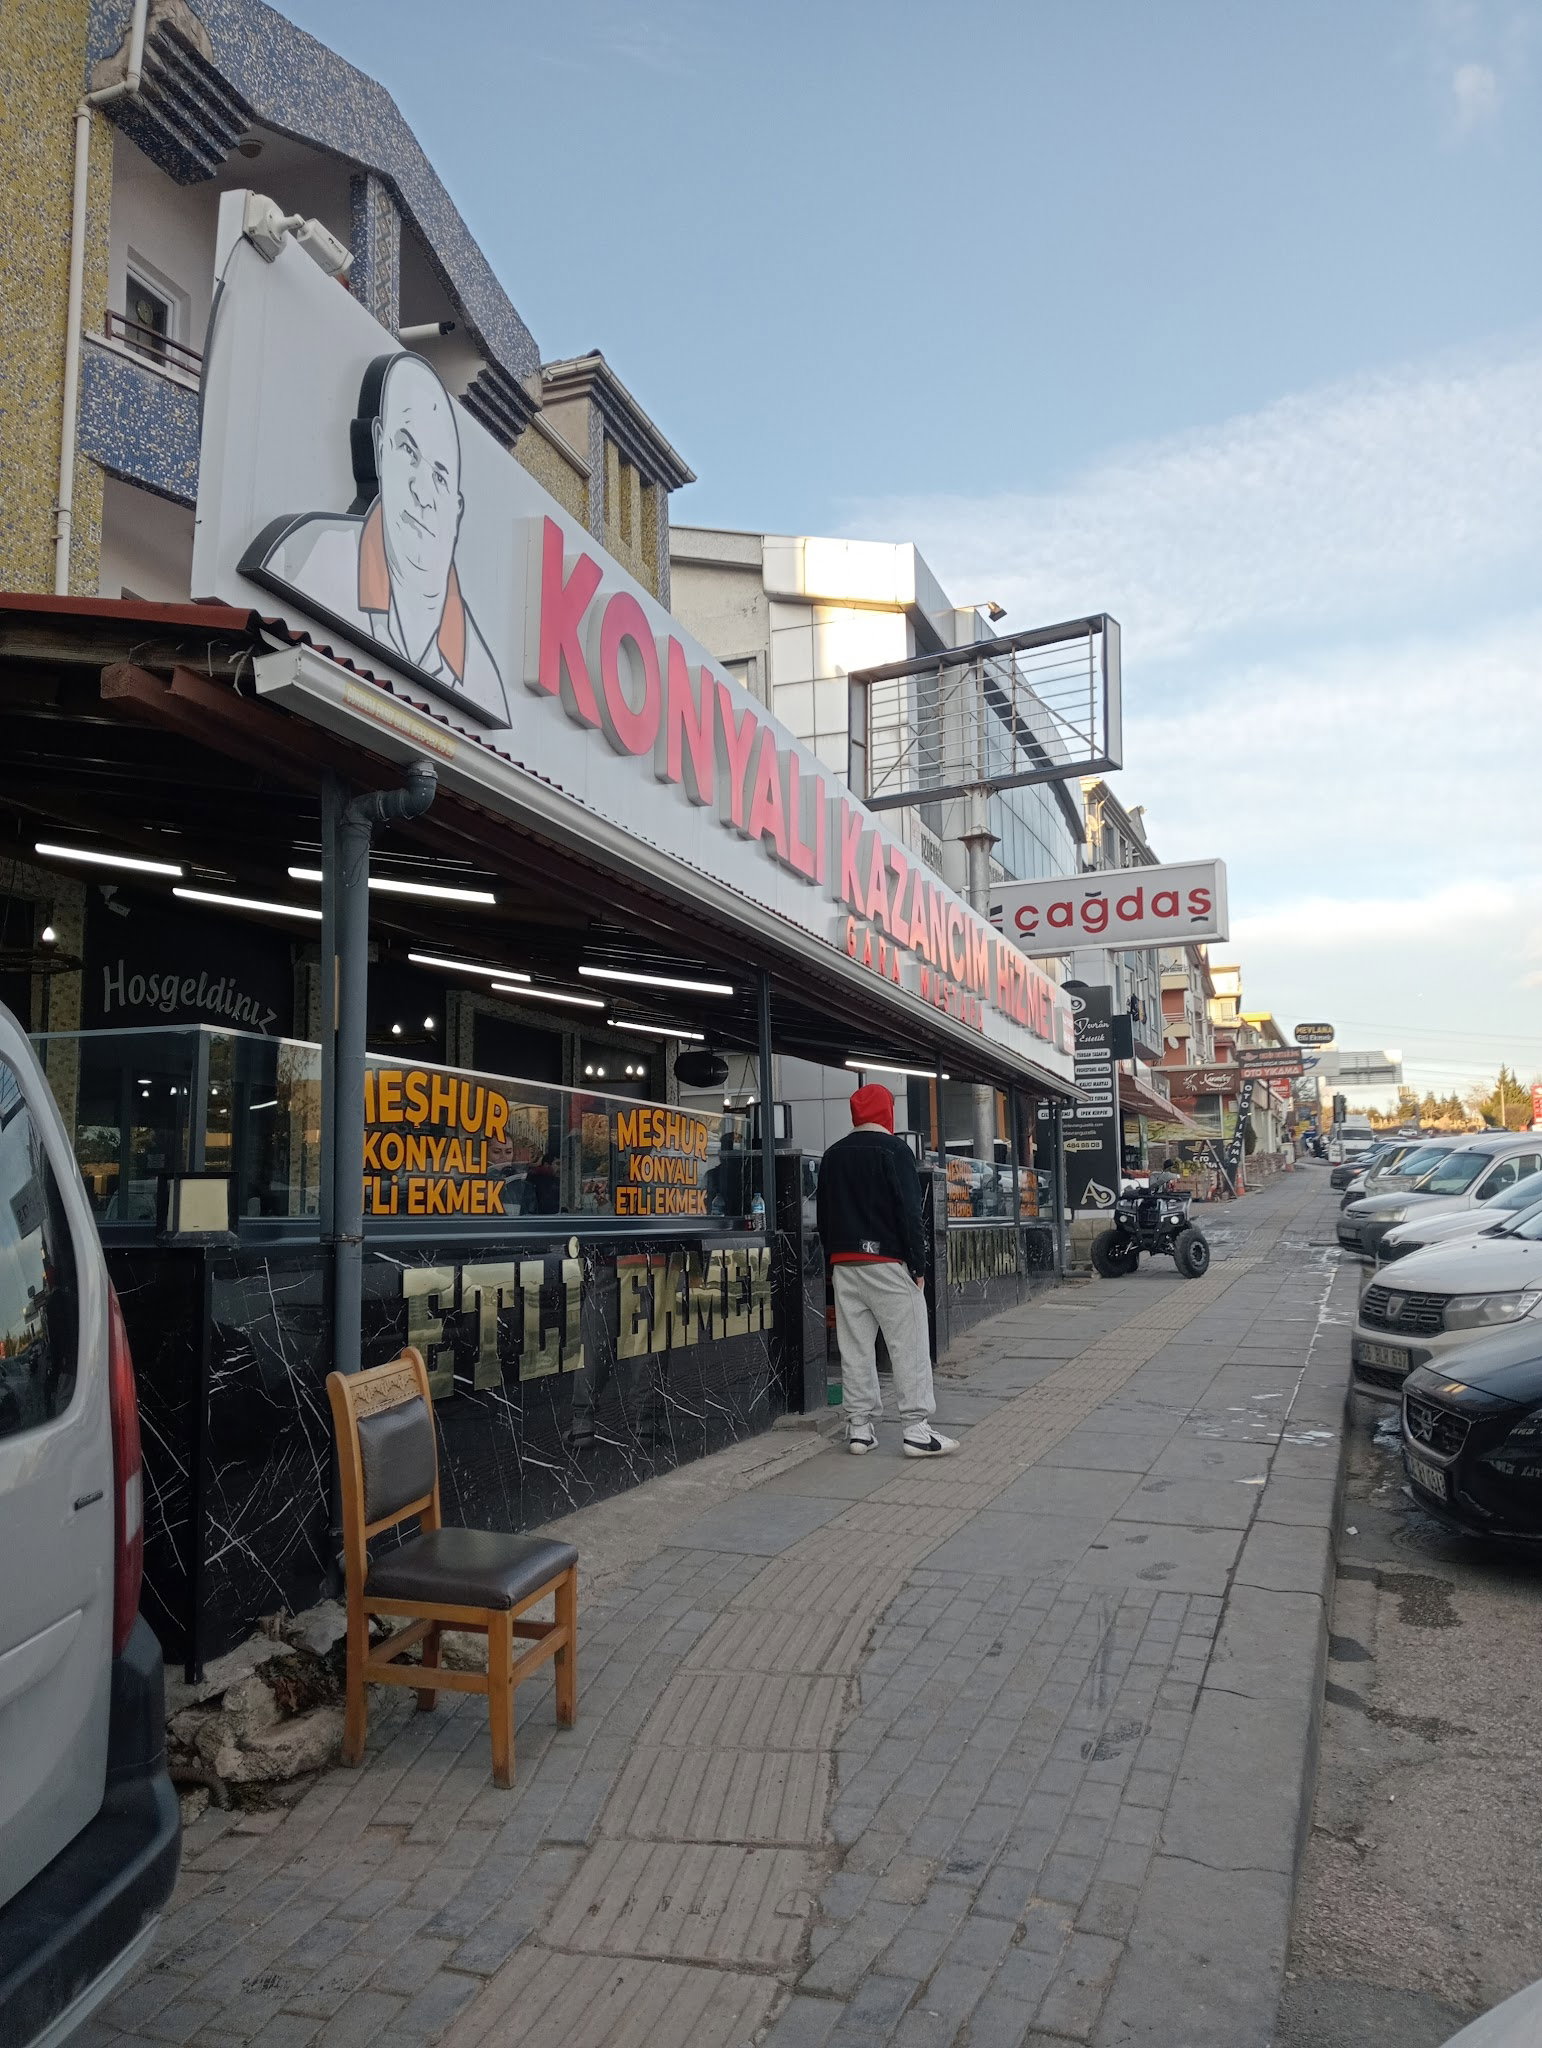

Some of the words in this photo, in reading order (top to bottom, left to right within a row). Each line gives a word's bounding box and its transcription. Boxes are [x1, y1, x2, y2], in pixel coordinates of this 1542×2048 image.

[536, 514, 826, 886] KONYALI
[840, 797, 990, 1001] KAZANCIM
[1014, 886, 1212, 940] çağdaş
[846, 915, 900, 985] GARA
[919, 964, 984, 1034] MUSTAFA
[1244, 1069, 1262, 1078] OTO
[1263, 1066, 1299, 1076] YIKAMA
[1241, 1085, 1253, 1108] OTO
[363, 1131, 488, 1175] KONYALI
[617, 1109, 709, 1161] MEŞHUR
[1230, 1114, 1247, 1164] YIKAMA
[629, 1153, 698, 1185] KONYALI
[408, 1178, 505, 1214] EKMEK
[655, 1187, 707, 1215] EKMEK
[616, 1247, 774, 1361] EKMEK
